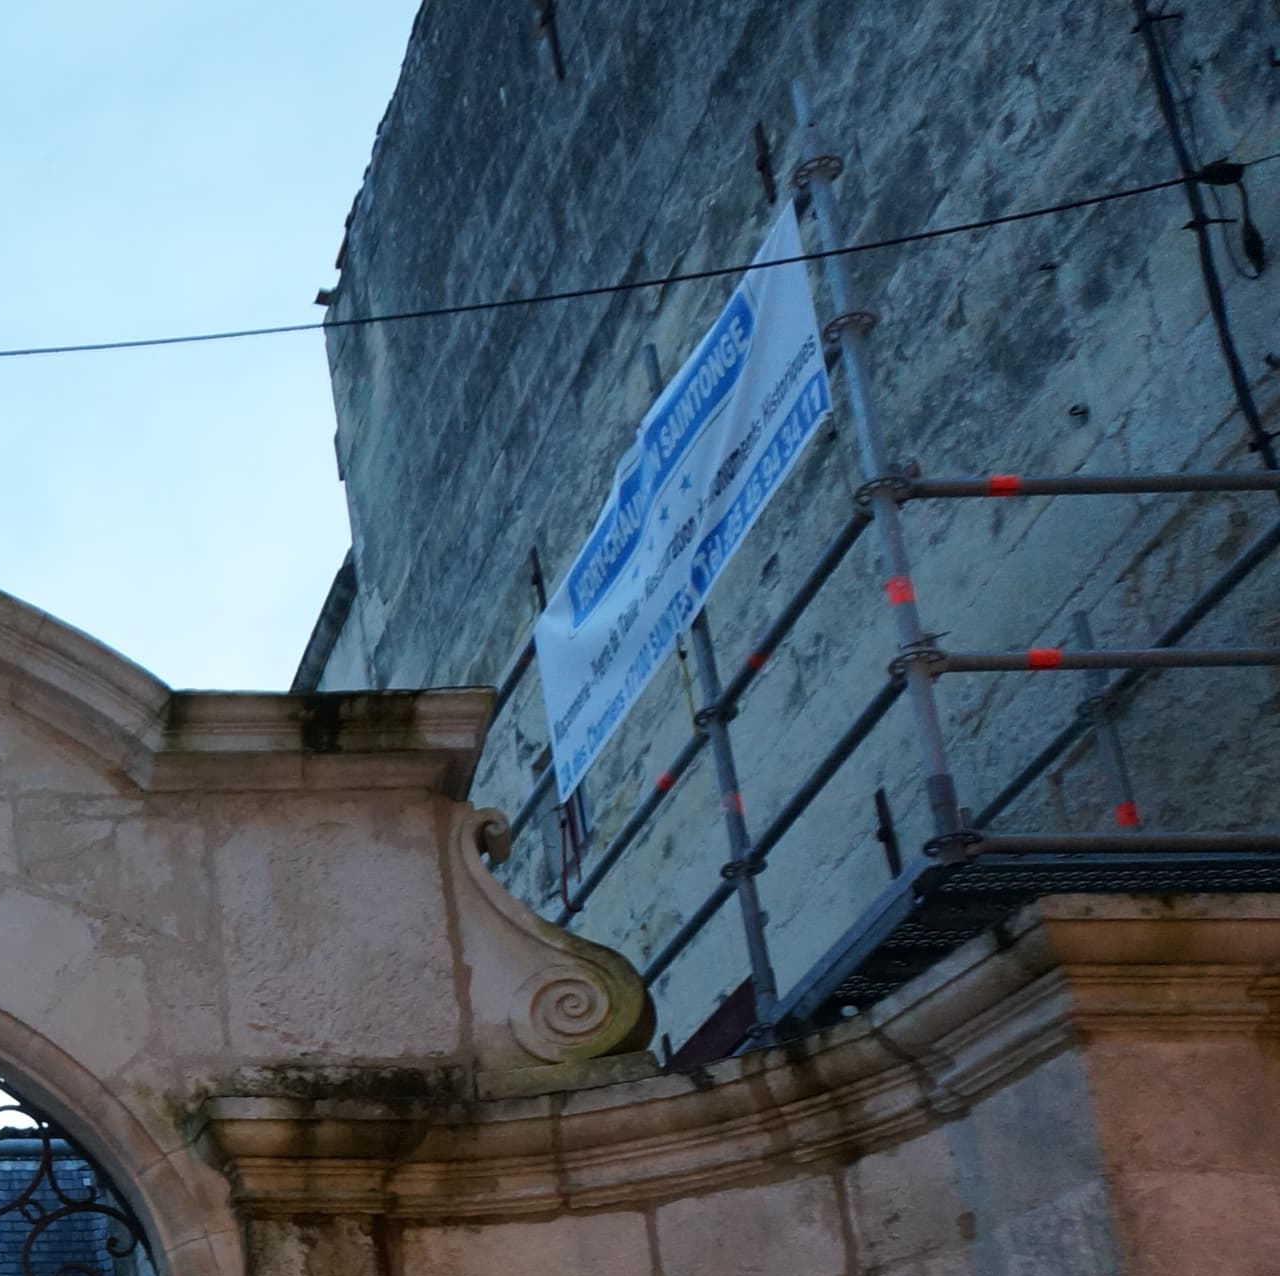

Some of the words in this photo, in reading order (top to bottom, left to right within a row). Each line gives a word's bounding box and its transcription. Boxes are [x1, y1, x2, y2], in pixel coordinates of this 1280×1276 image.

[659, 316, 748, 457] SAINTONGE
[761, 333, 816, 428] Historiques
[649, 584, 693, 660] SAINTES
